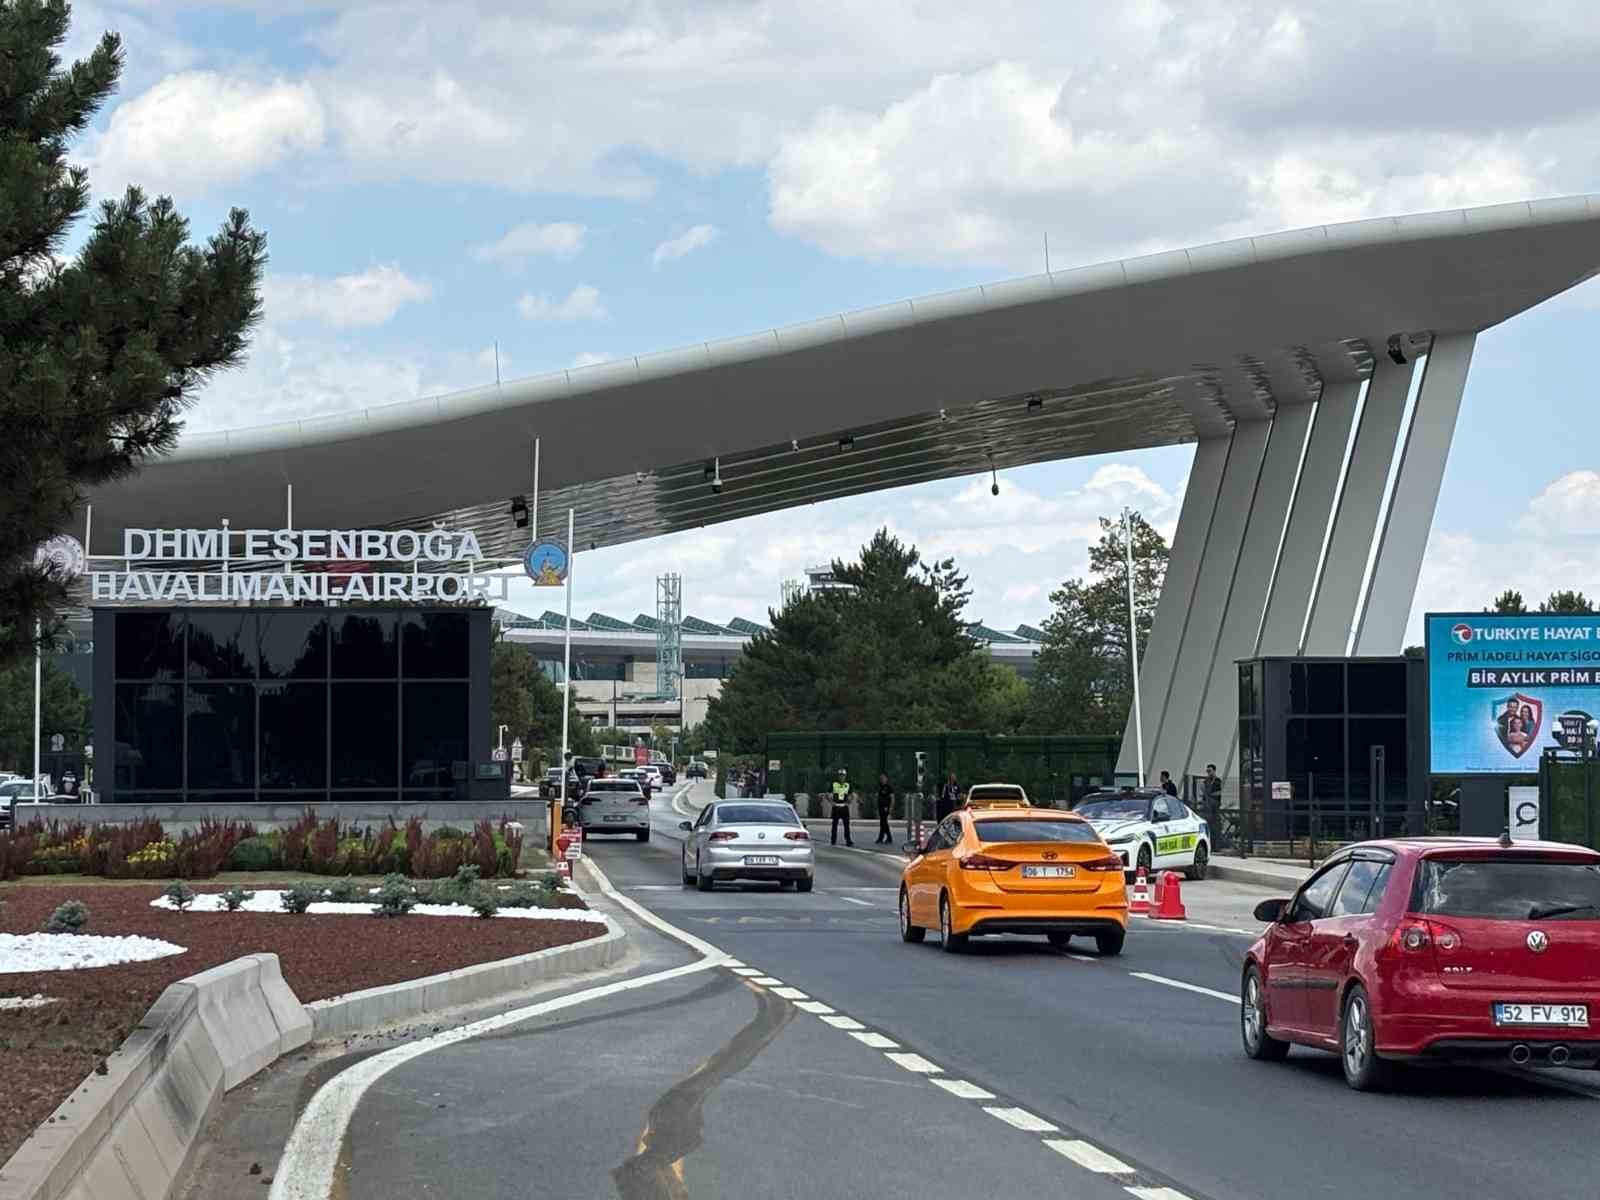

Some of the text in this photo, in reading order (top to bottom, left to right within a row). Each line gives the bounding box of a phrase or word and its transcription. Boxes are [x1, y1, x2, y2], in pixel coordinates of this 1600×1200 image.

[245, 521, 483, 561] ESENBOĞA
[1544, 627, 1592, 641] HAYAT
[1527, 651, 1568, 662] HAYAT
[1471, 669, 1496, 684] BİR
[1501, 672, 1546, 684] AYLIK
[1551, 669, 1589, 684] PRİM
[1503, 1005, 1586, 1022] 52 FV 912
